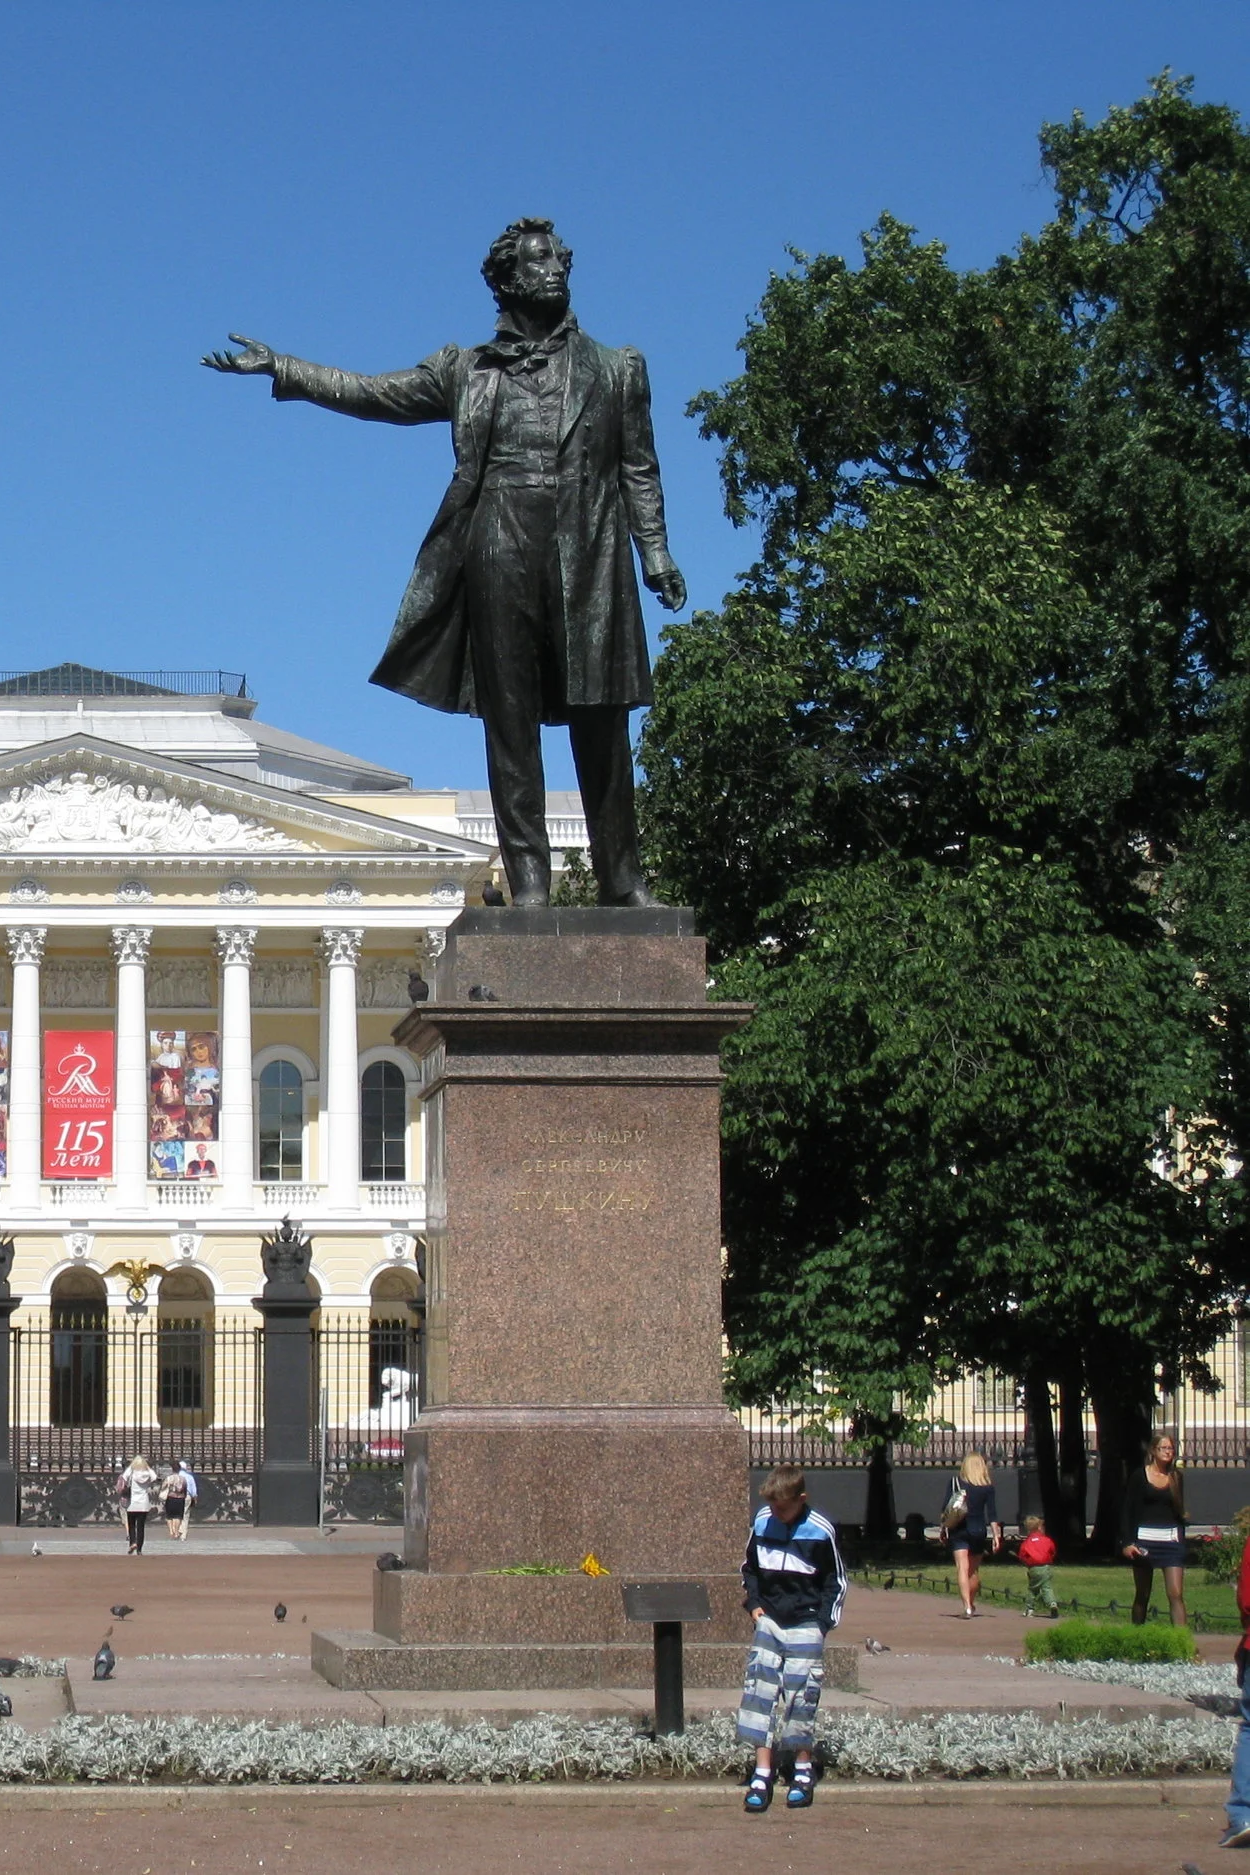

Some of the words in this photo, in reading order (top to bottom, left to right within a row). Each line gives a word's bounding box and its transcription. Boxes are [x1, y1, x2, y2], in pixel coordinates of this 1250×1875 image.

[54, 1120, 107, 1156] 115
[50, 1152, 101, 1167] лет
[521, 1160, 647, 1172] СЕРГЕЕВИЧУ
[514, 1191, 654, 1211] ПУШКИНУ
